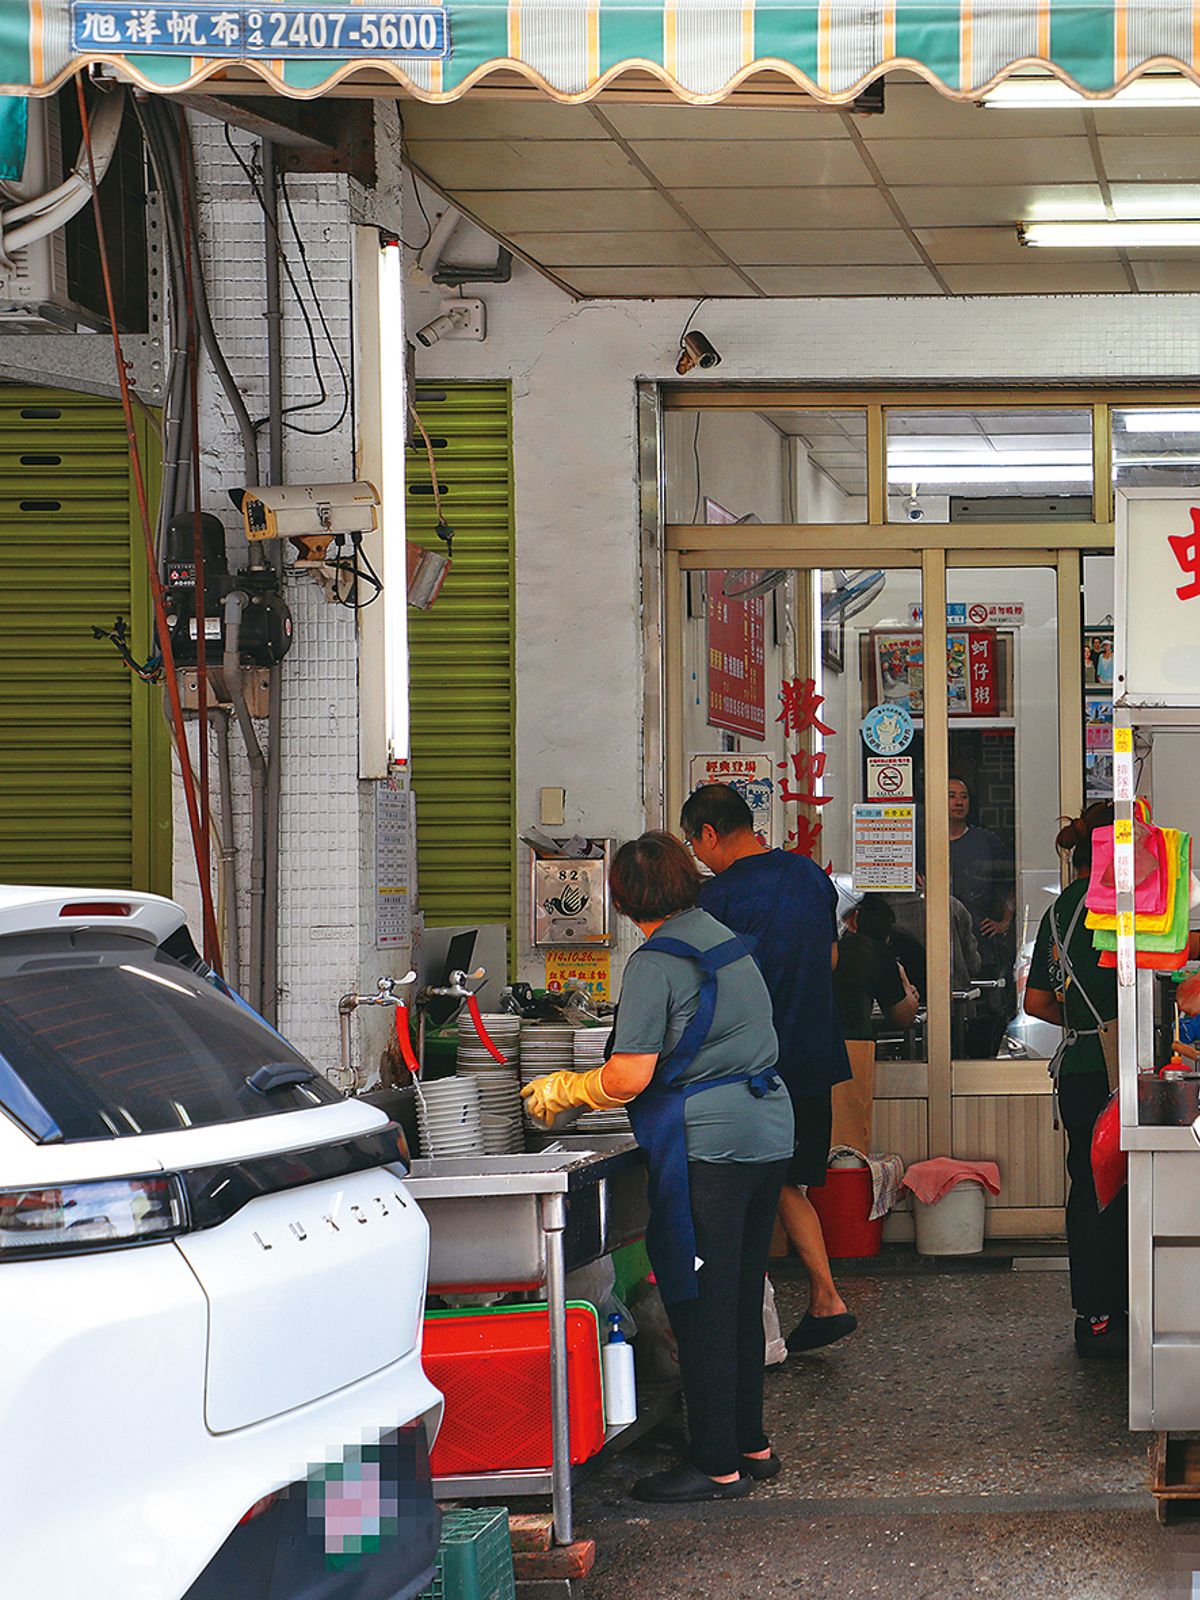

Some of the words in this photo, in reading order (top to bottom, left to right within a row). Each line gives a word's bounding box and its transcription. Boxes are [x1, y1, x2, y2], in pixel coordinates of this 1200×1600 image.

[81, 10, 240, 46] 旭祥帆布
[270, 14, 438, 49] 2407-5600
[971, 639, 991, 705] 蚵仔粥
[559, 870, 578, 880] 82
